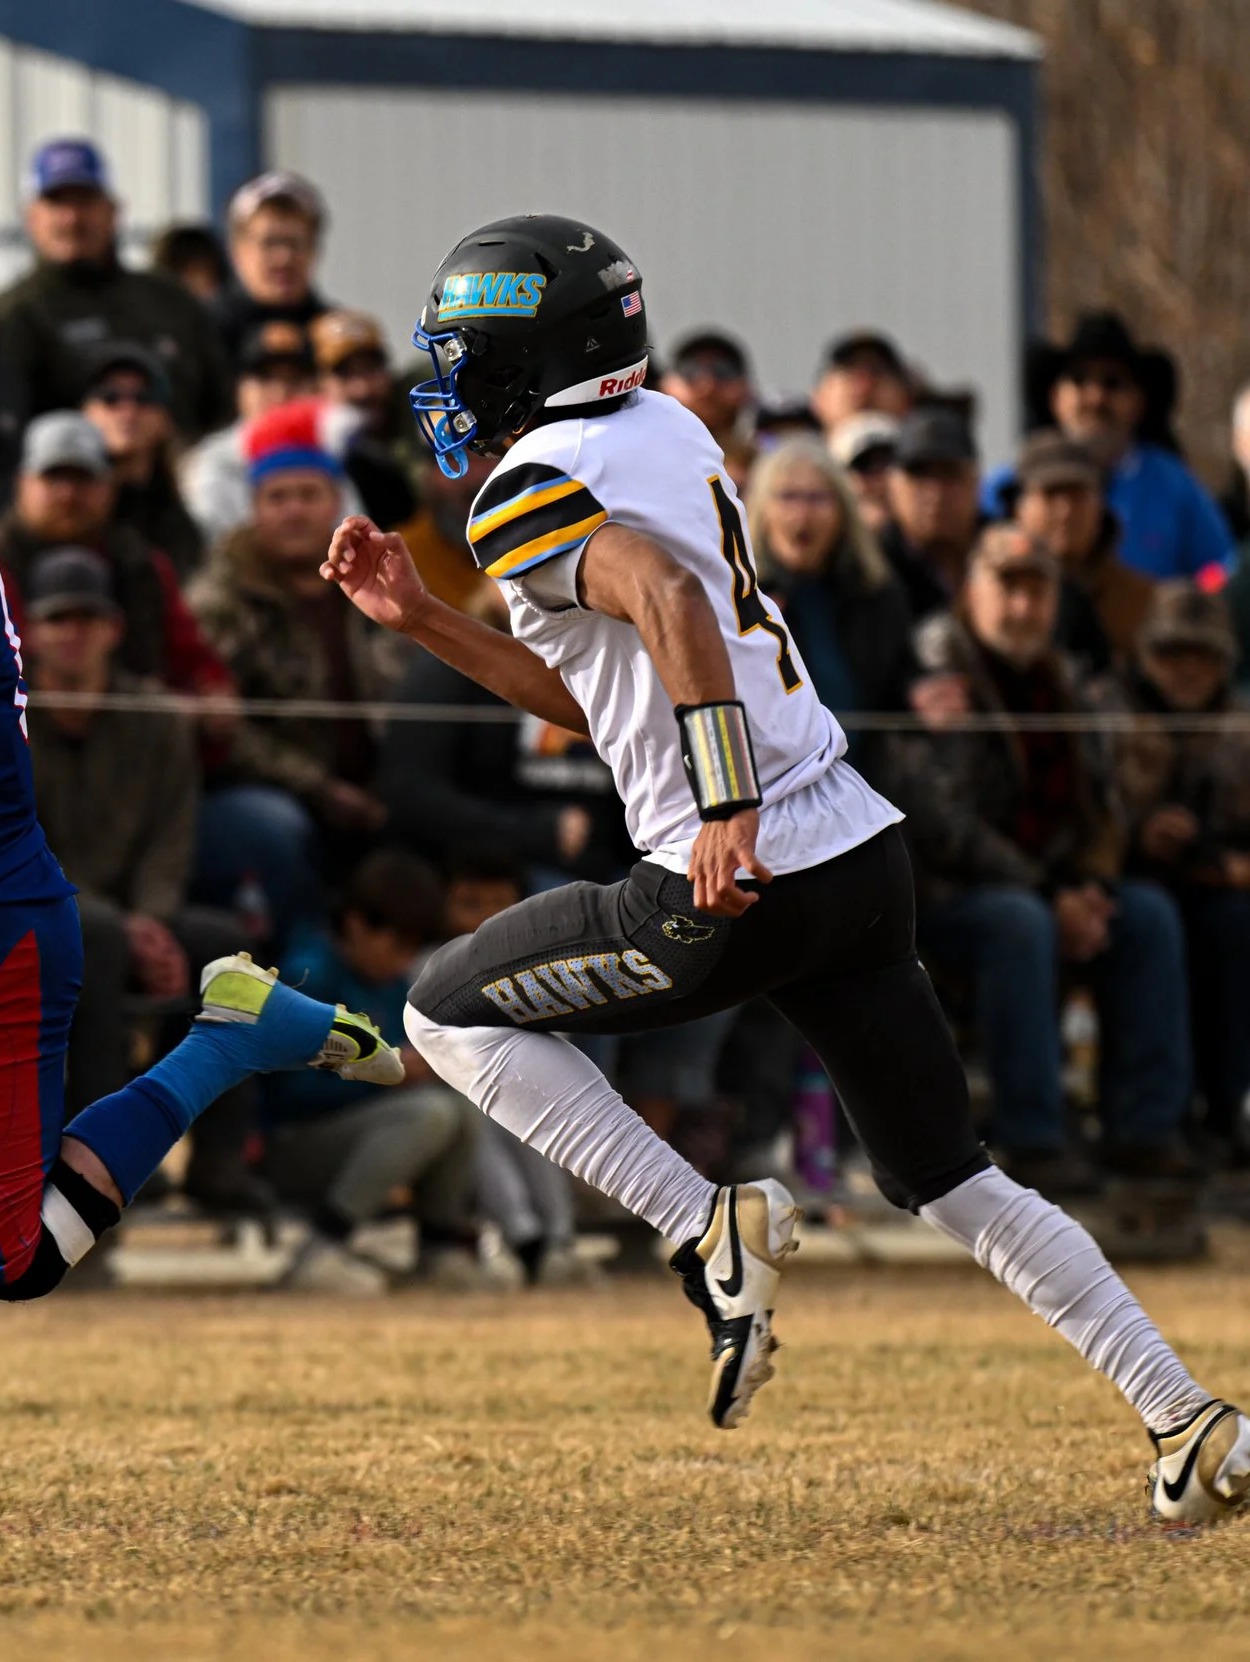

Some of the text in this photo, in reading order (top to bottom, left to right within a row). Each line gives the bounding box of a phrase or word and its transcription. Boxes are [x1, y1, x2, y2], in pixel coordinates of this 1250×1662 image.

[440, 272, 547, 309] HAWKS
[598, 367, 647, 397] Ridd
[706, 473, 804, 696] 4
[481, 949, 673, 1025] HAWKS
